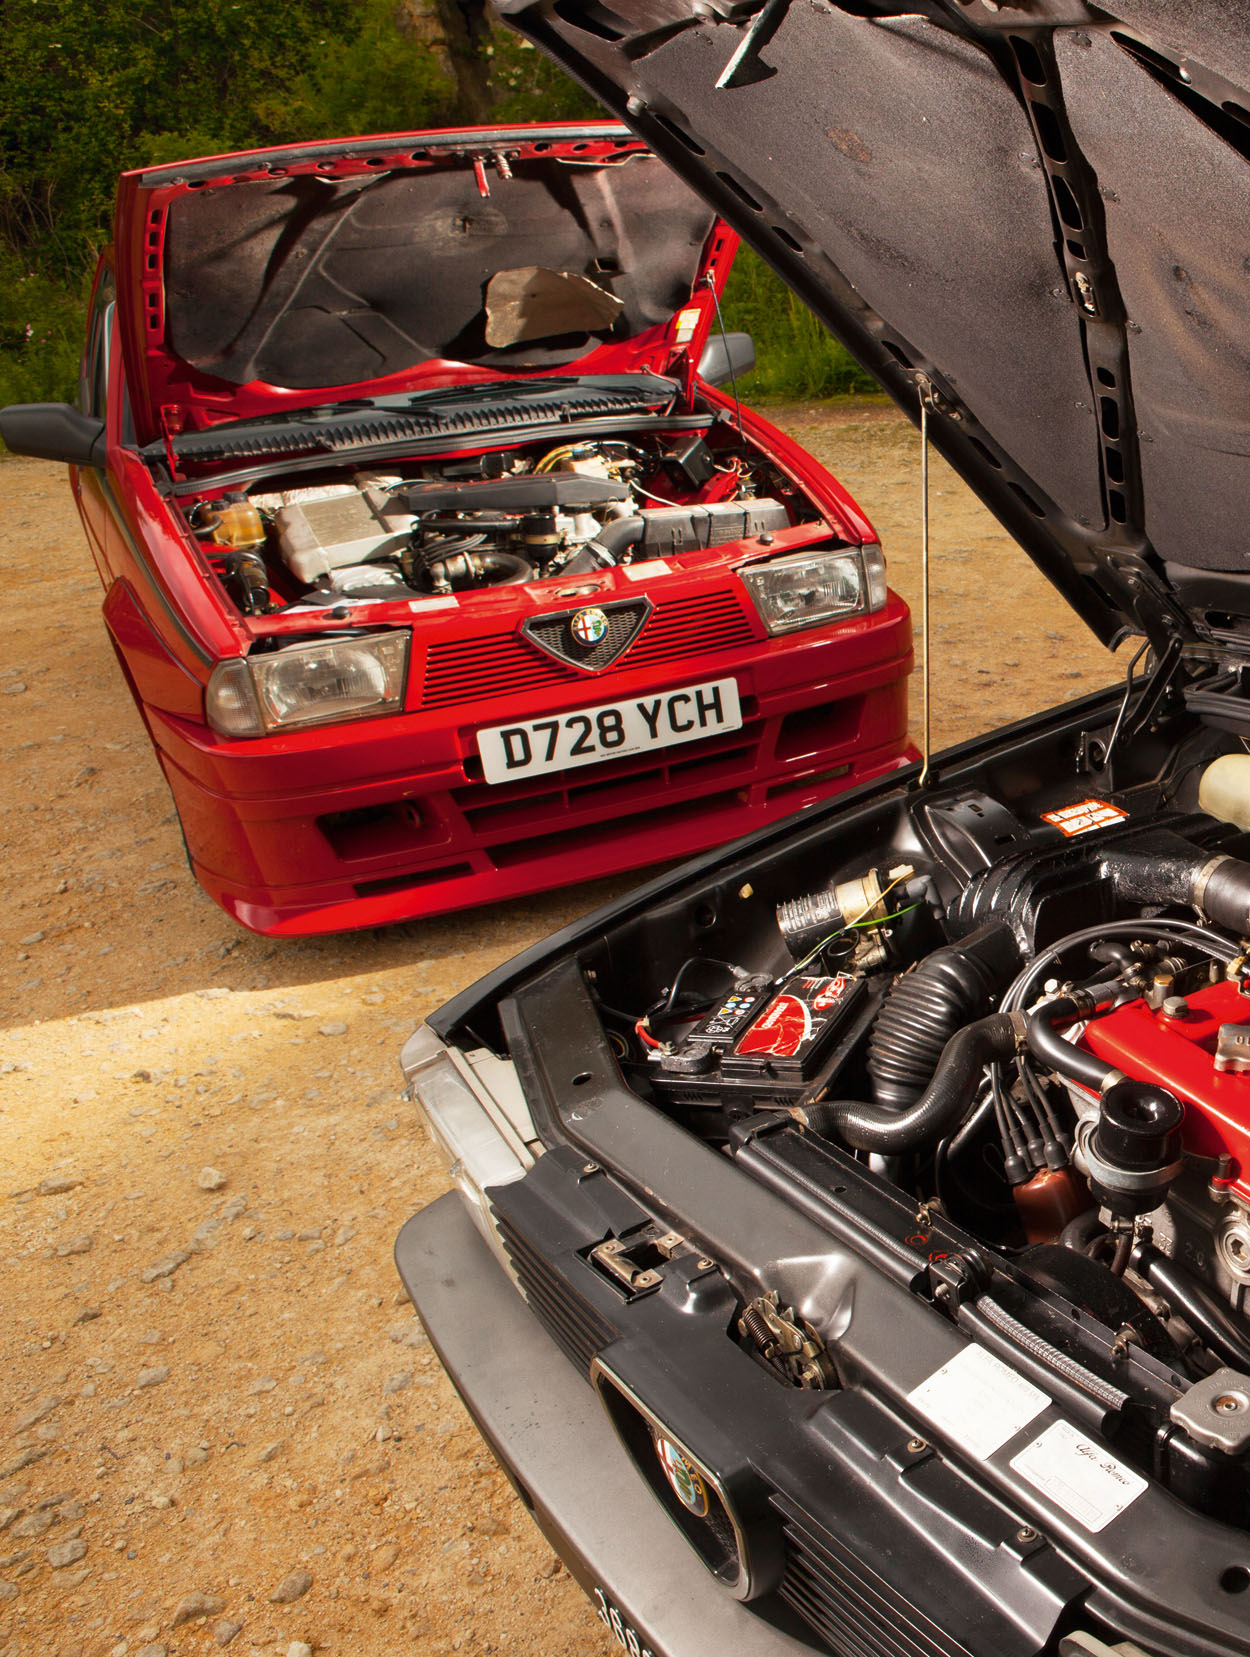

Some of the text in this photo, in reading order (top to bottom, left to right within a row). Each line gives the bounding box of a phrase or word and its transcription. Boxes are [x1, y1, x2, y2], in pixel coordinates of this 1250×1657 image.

[500, 686, 724, 769] D728 YCH
[1075, 1443, 1130, 1485] Alfa Romeo
